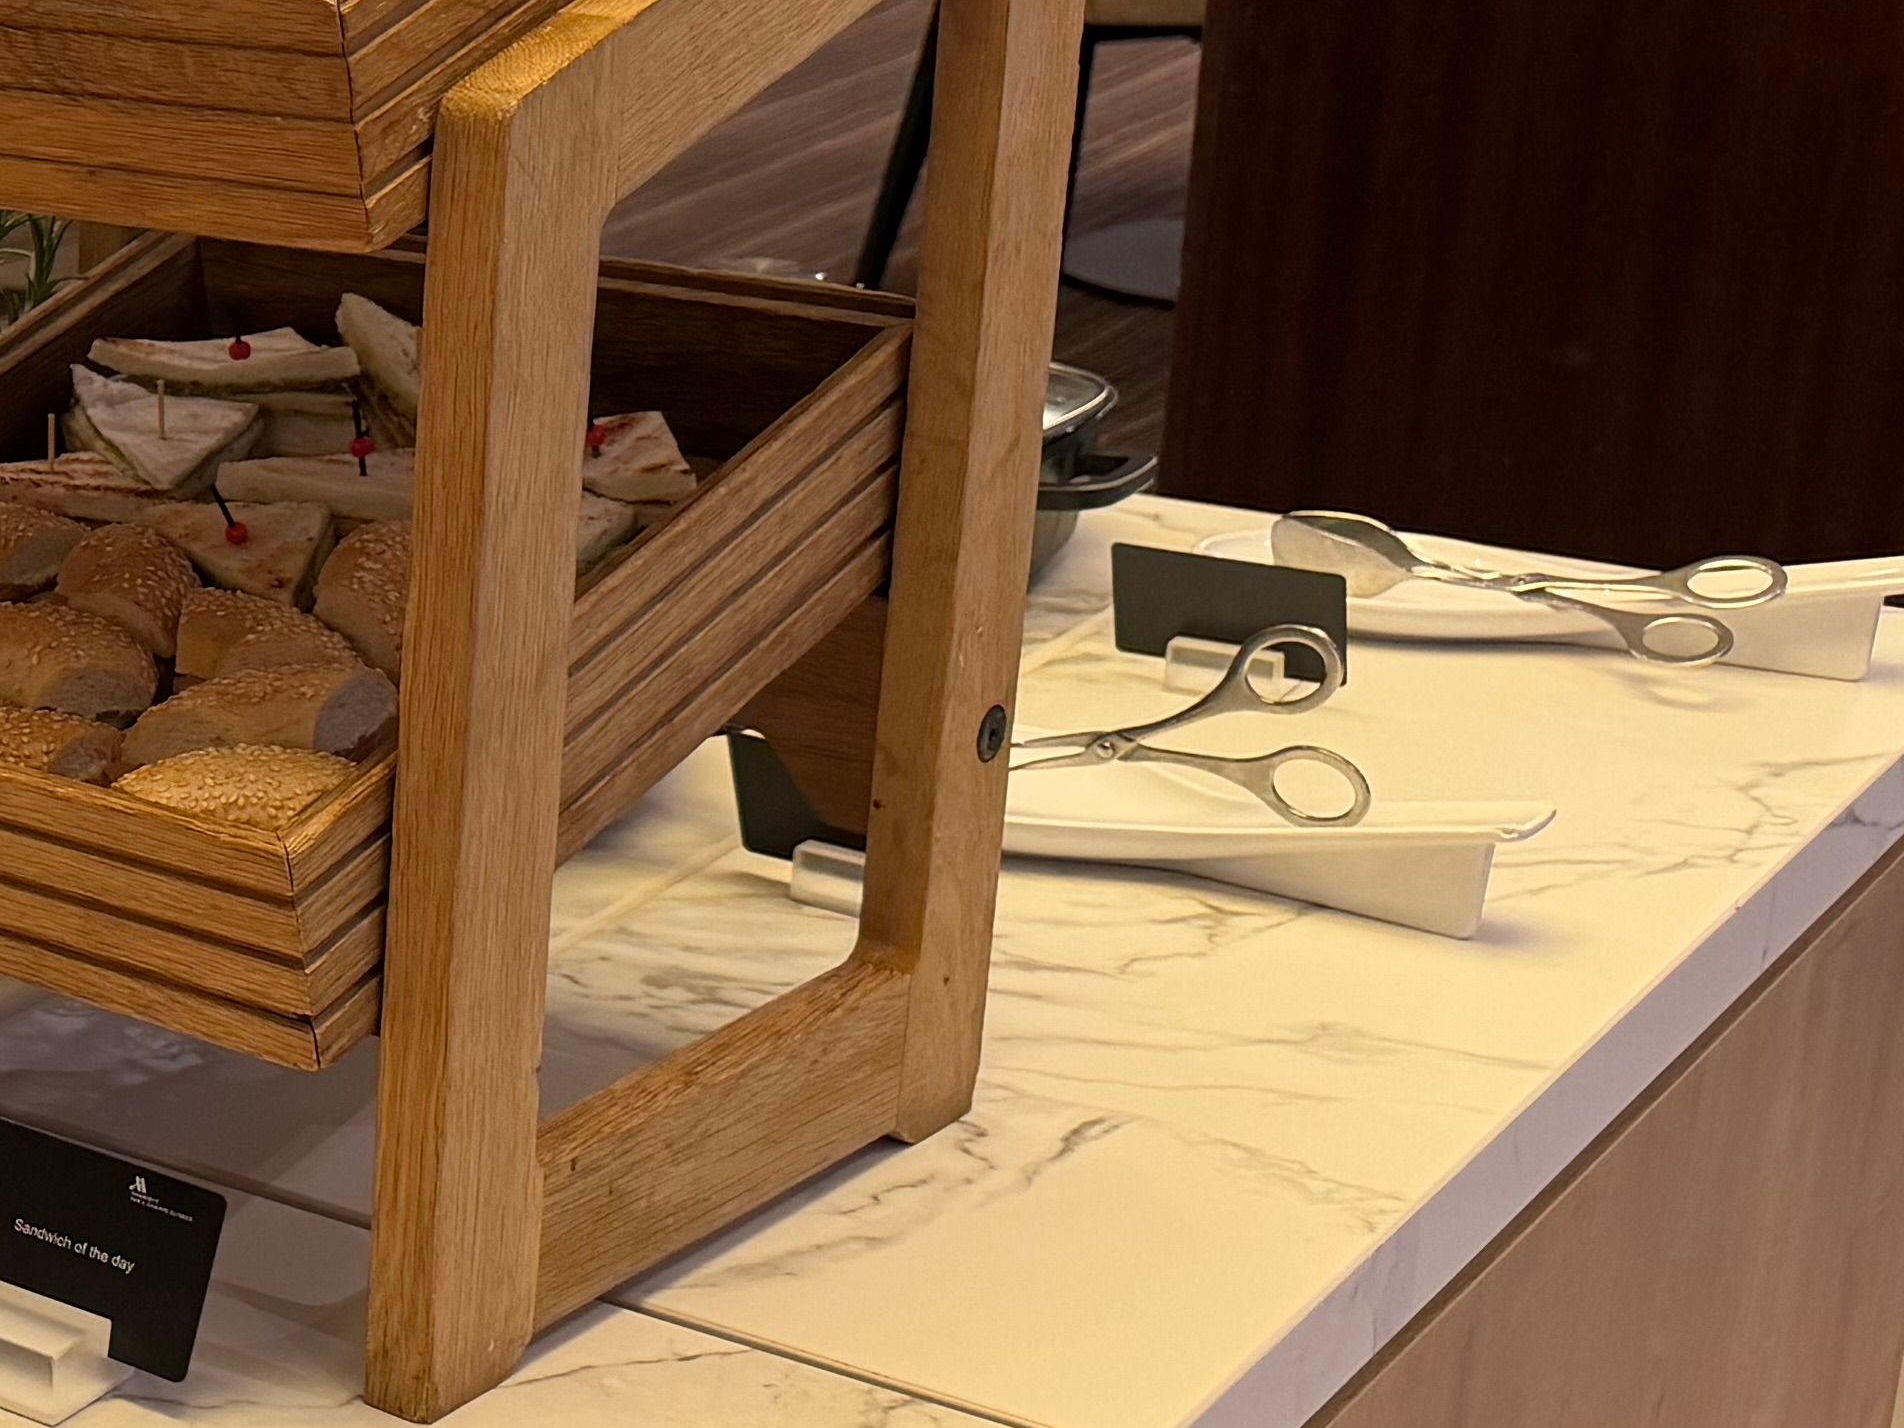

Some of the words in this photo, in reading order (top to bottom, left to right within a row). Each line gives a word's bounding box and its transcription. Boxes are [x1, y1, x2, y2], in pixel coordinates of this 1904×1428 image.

[14, 1218, 72, 1250] Sandwich
[74, 1242, 88, 1255] of
[89, 1246, 109, 1263] the
[111, 1255, 136, 1274] day
